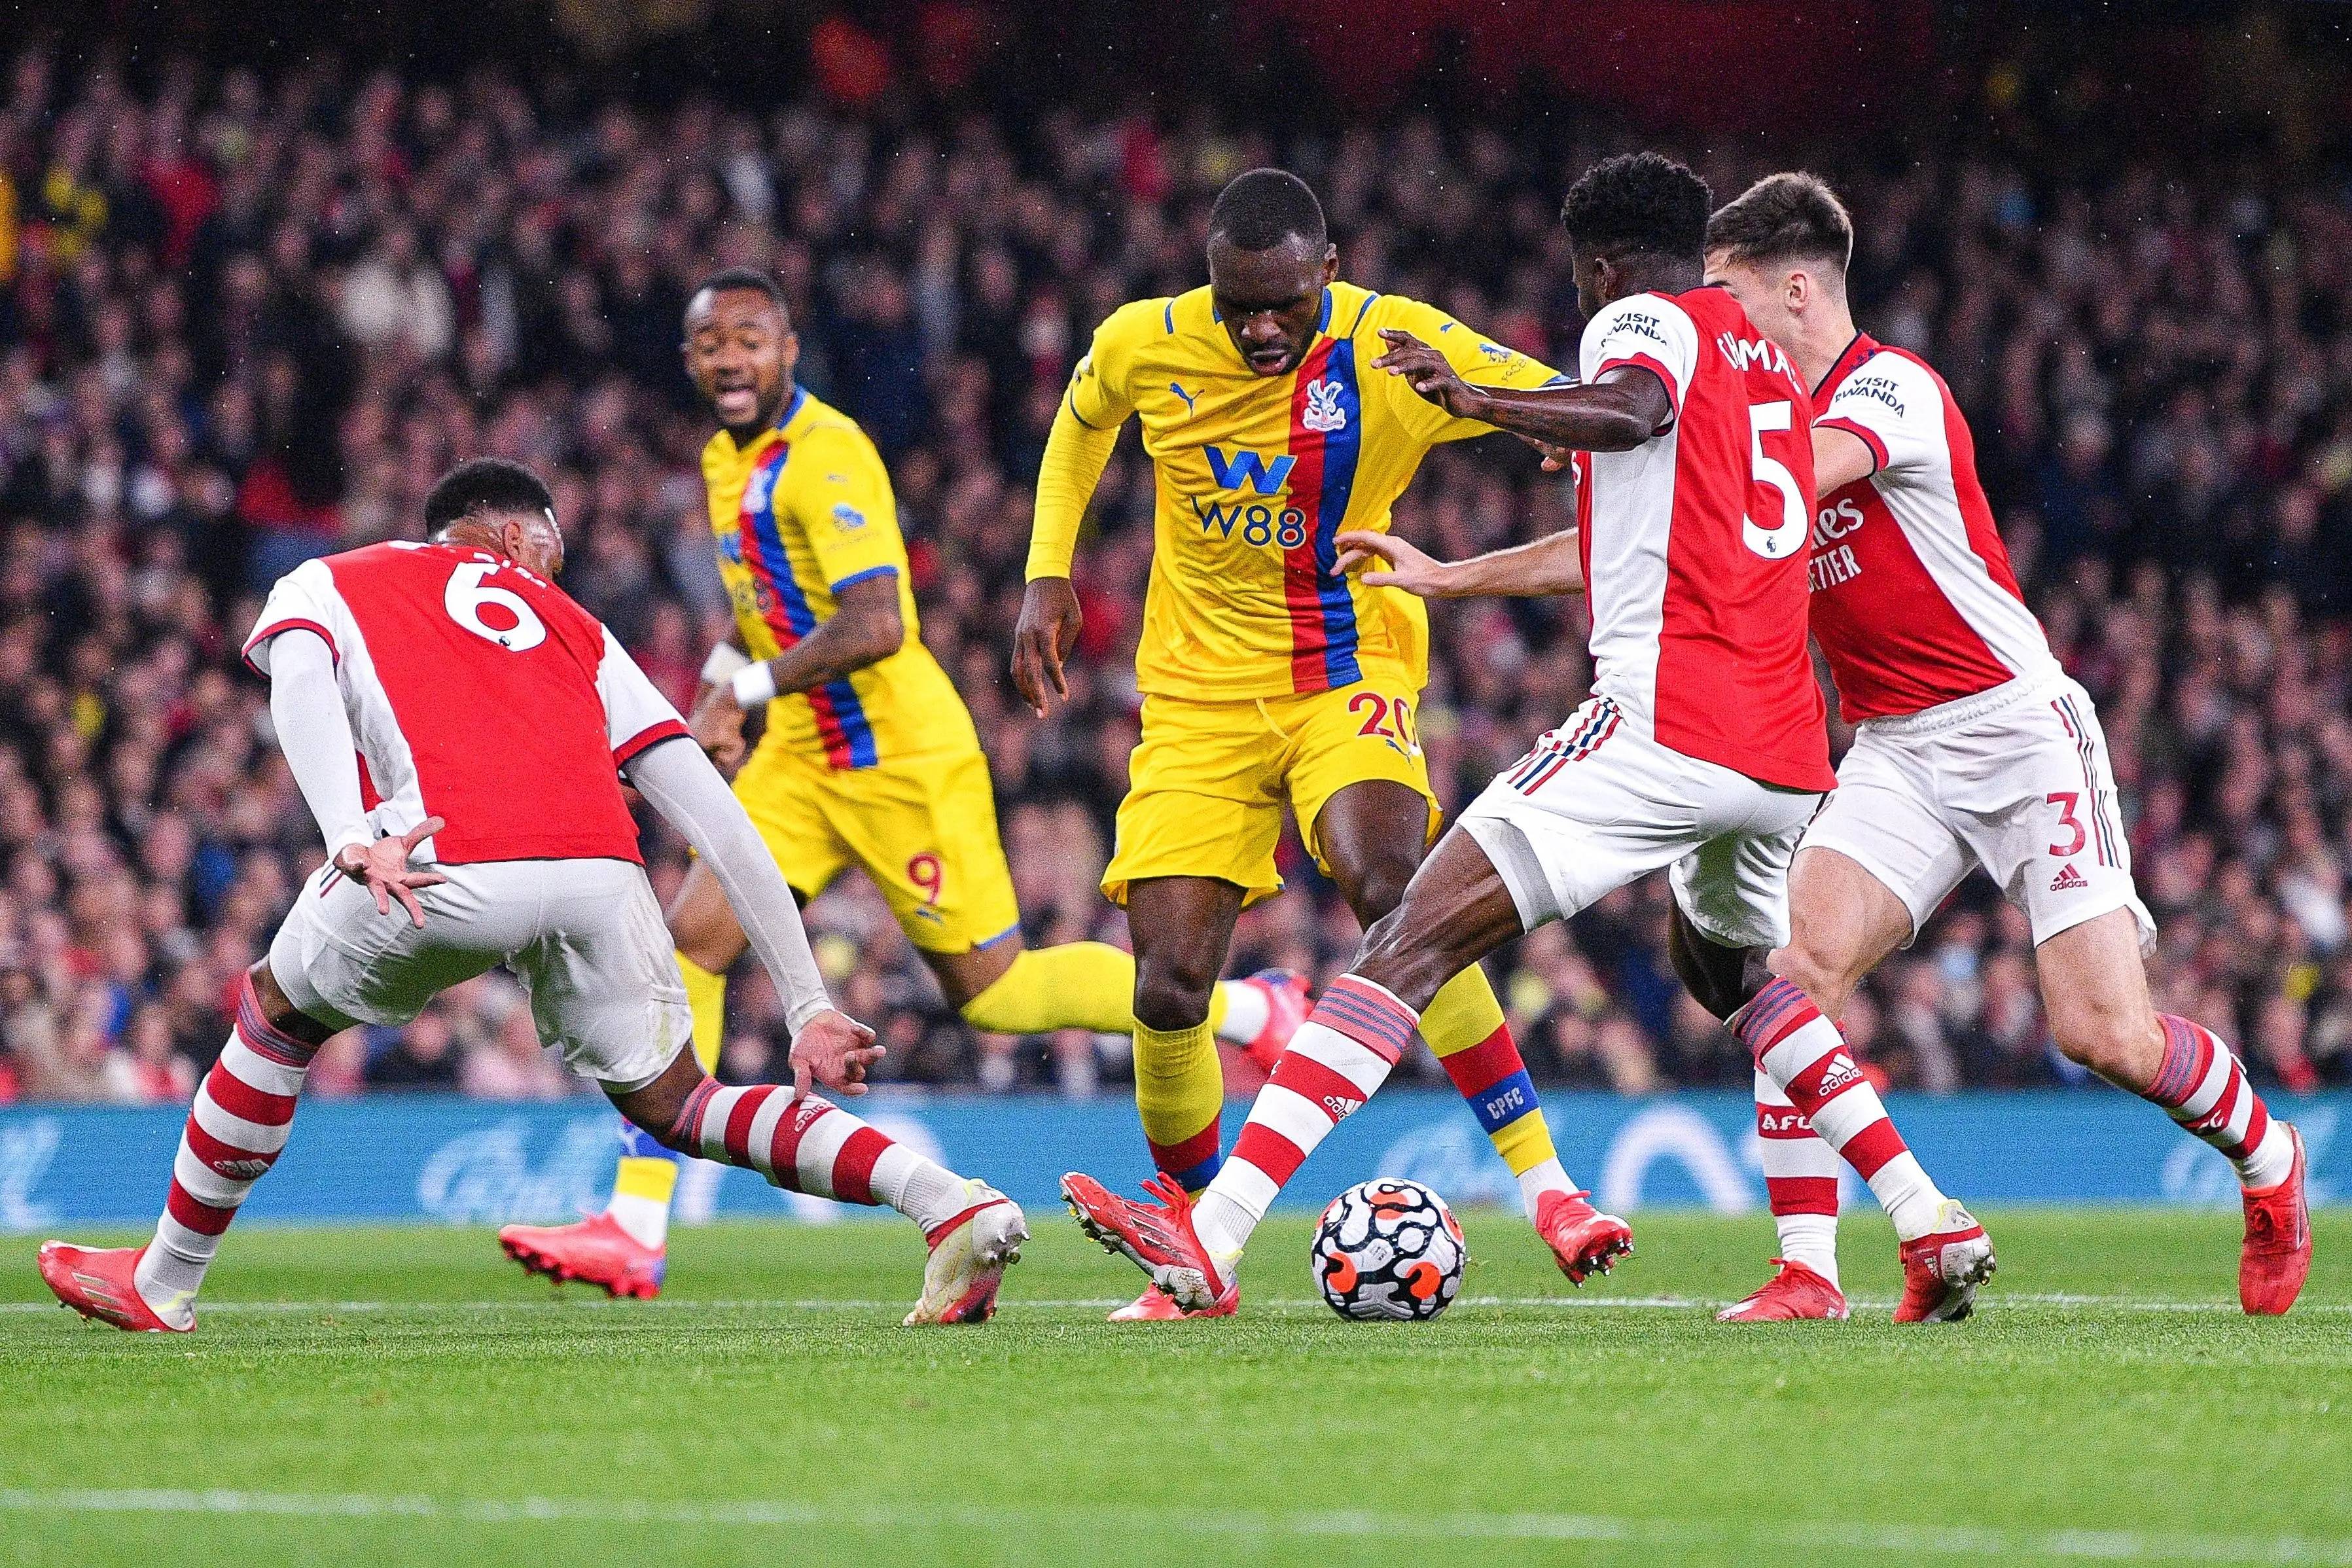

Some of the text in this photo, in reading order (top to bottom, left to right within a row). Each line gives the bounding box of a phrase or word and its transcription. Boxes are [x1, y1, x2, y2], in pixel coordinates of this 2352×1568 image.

[1601, 323, 1667, 348] WAND
[1612, 313, 1660, 327] VISIT
[1854, 378, 1899, 391] VISIT
[1835, 387, 1905, 418] RWANDA
[1742, 400, 1809, 560] 5
[1190, 495, 1307, 550] W88
[444, 561, 548, 652] 6
[1348, 692, 1417, 747] 20
[2046, 792, 2086, 857] 3
[907, 853, 941, 906] 9
[2050, 880, 2088, 891] adidas
[1487, 1087, 1524, 1120] CPFC
[1761, 1113, 1813, 1131] AFC
